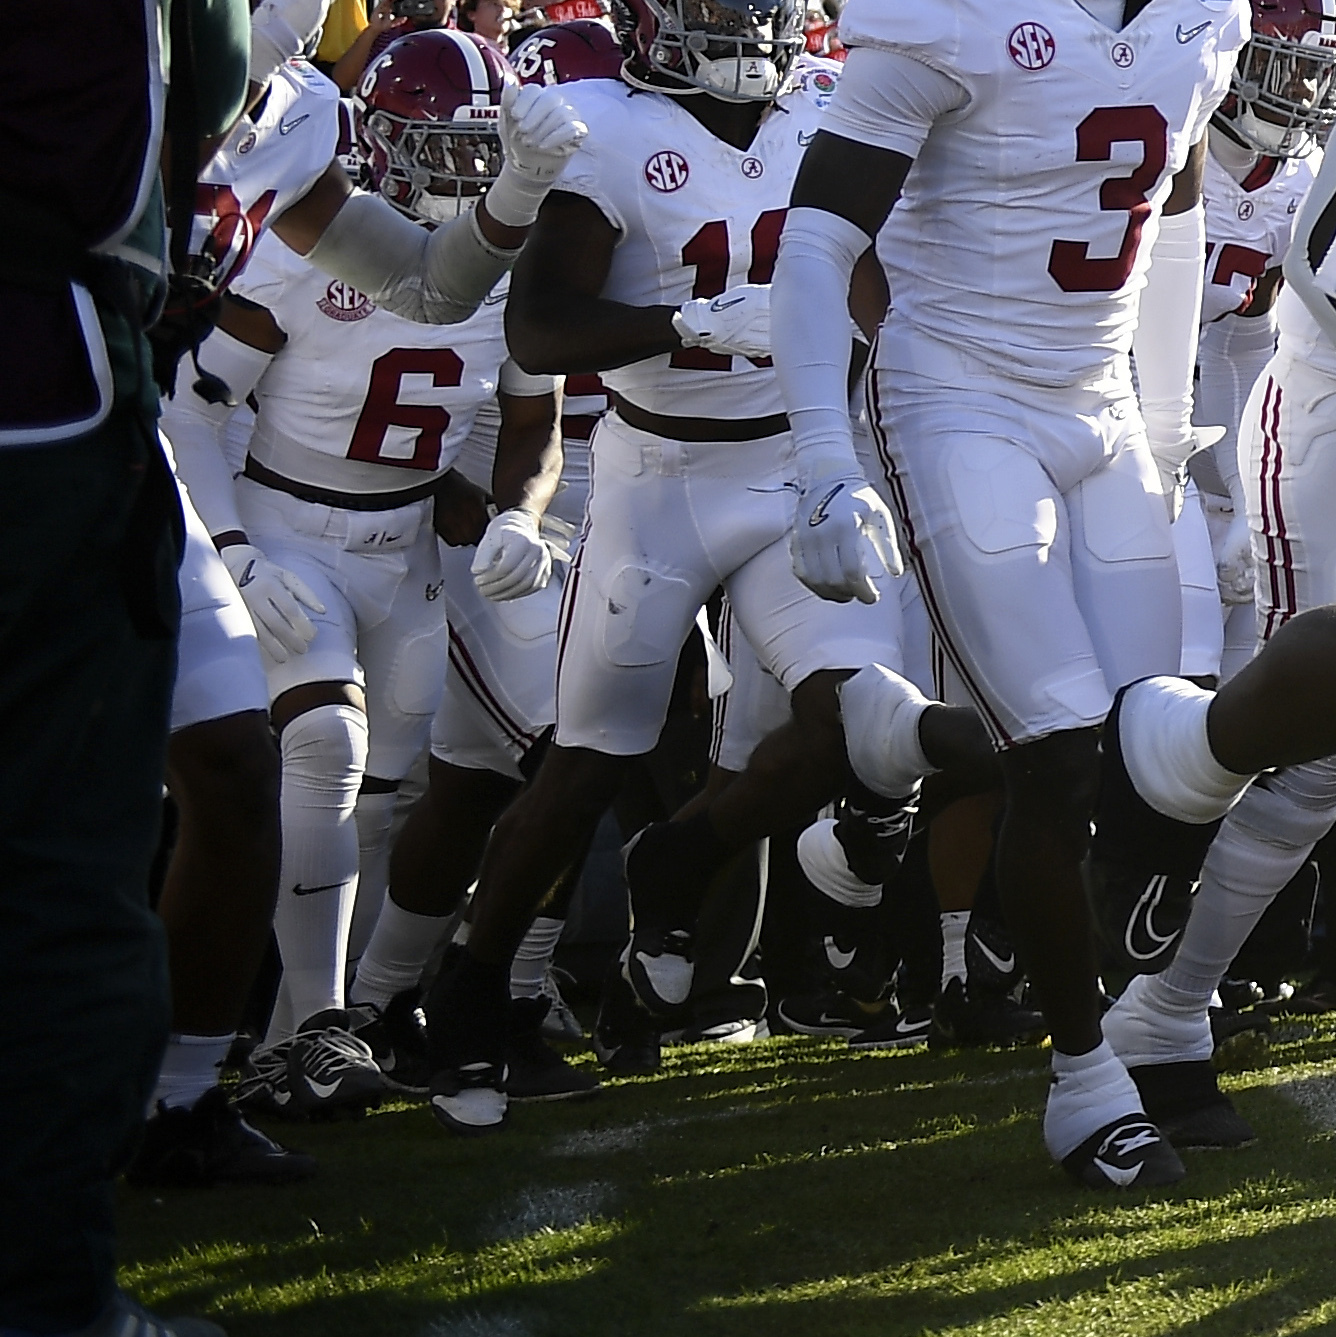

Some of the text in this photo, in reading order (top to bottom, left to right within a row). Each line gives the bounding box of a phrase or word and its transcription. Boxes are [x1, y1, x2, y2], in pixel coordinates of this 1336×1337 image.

[1010, 24, 1054, 68] SEC
[361, 54, 393, 99] 6
[646, 152, 688, 191] SEC
[1047, 104, 1169, 292] 3
[346, 347, 464, 471] 6
